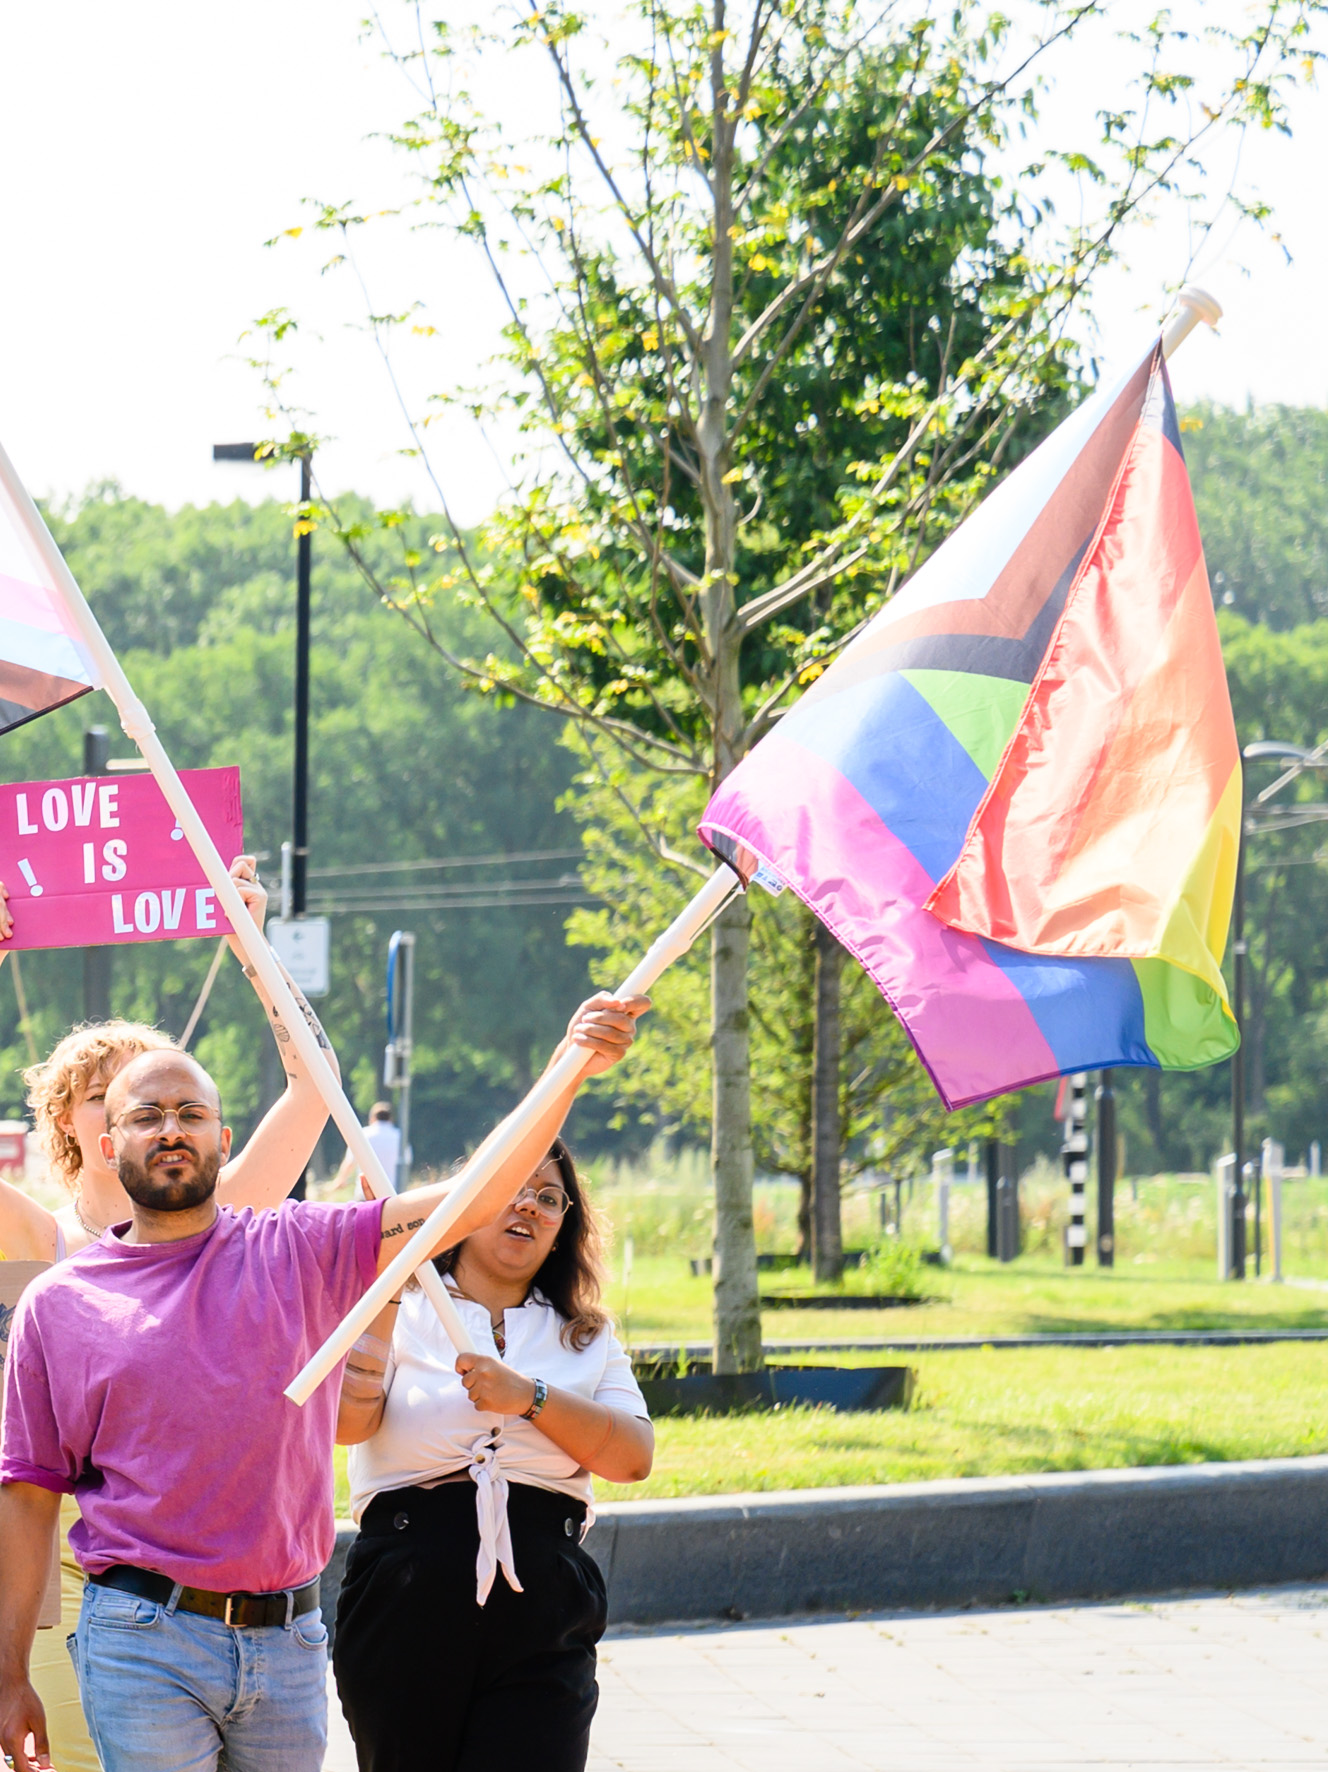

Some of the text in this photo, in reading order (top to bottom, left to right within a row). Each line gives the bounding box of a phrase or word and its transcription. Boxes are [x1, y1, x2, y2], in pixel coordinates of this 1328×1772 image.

[16, 782, 120, 835] LOVE
[83, 839, 128, 884] IS
[111, 888, 216, 934] LOVE
